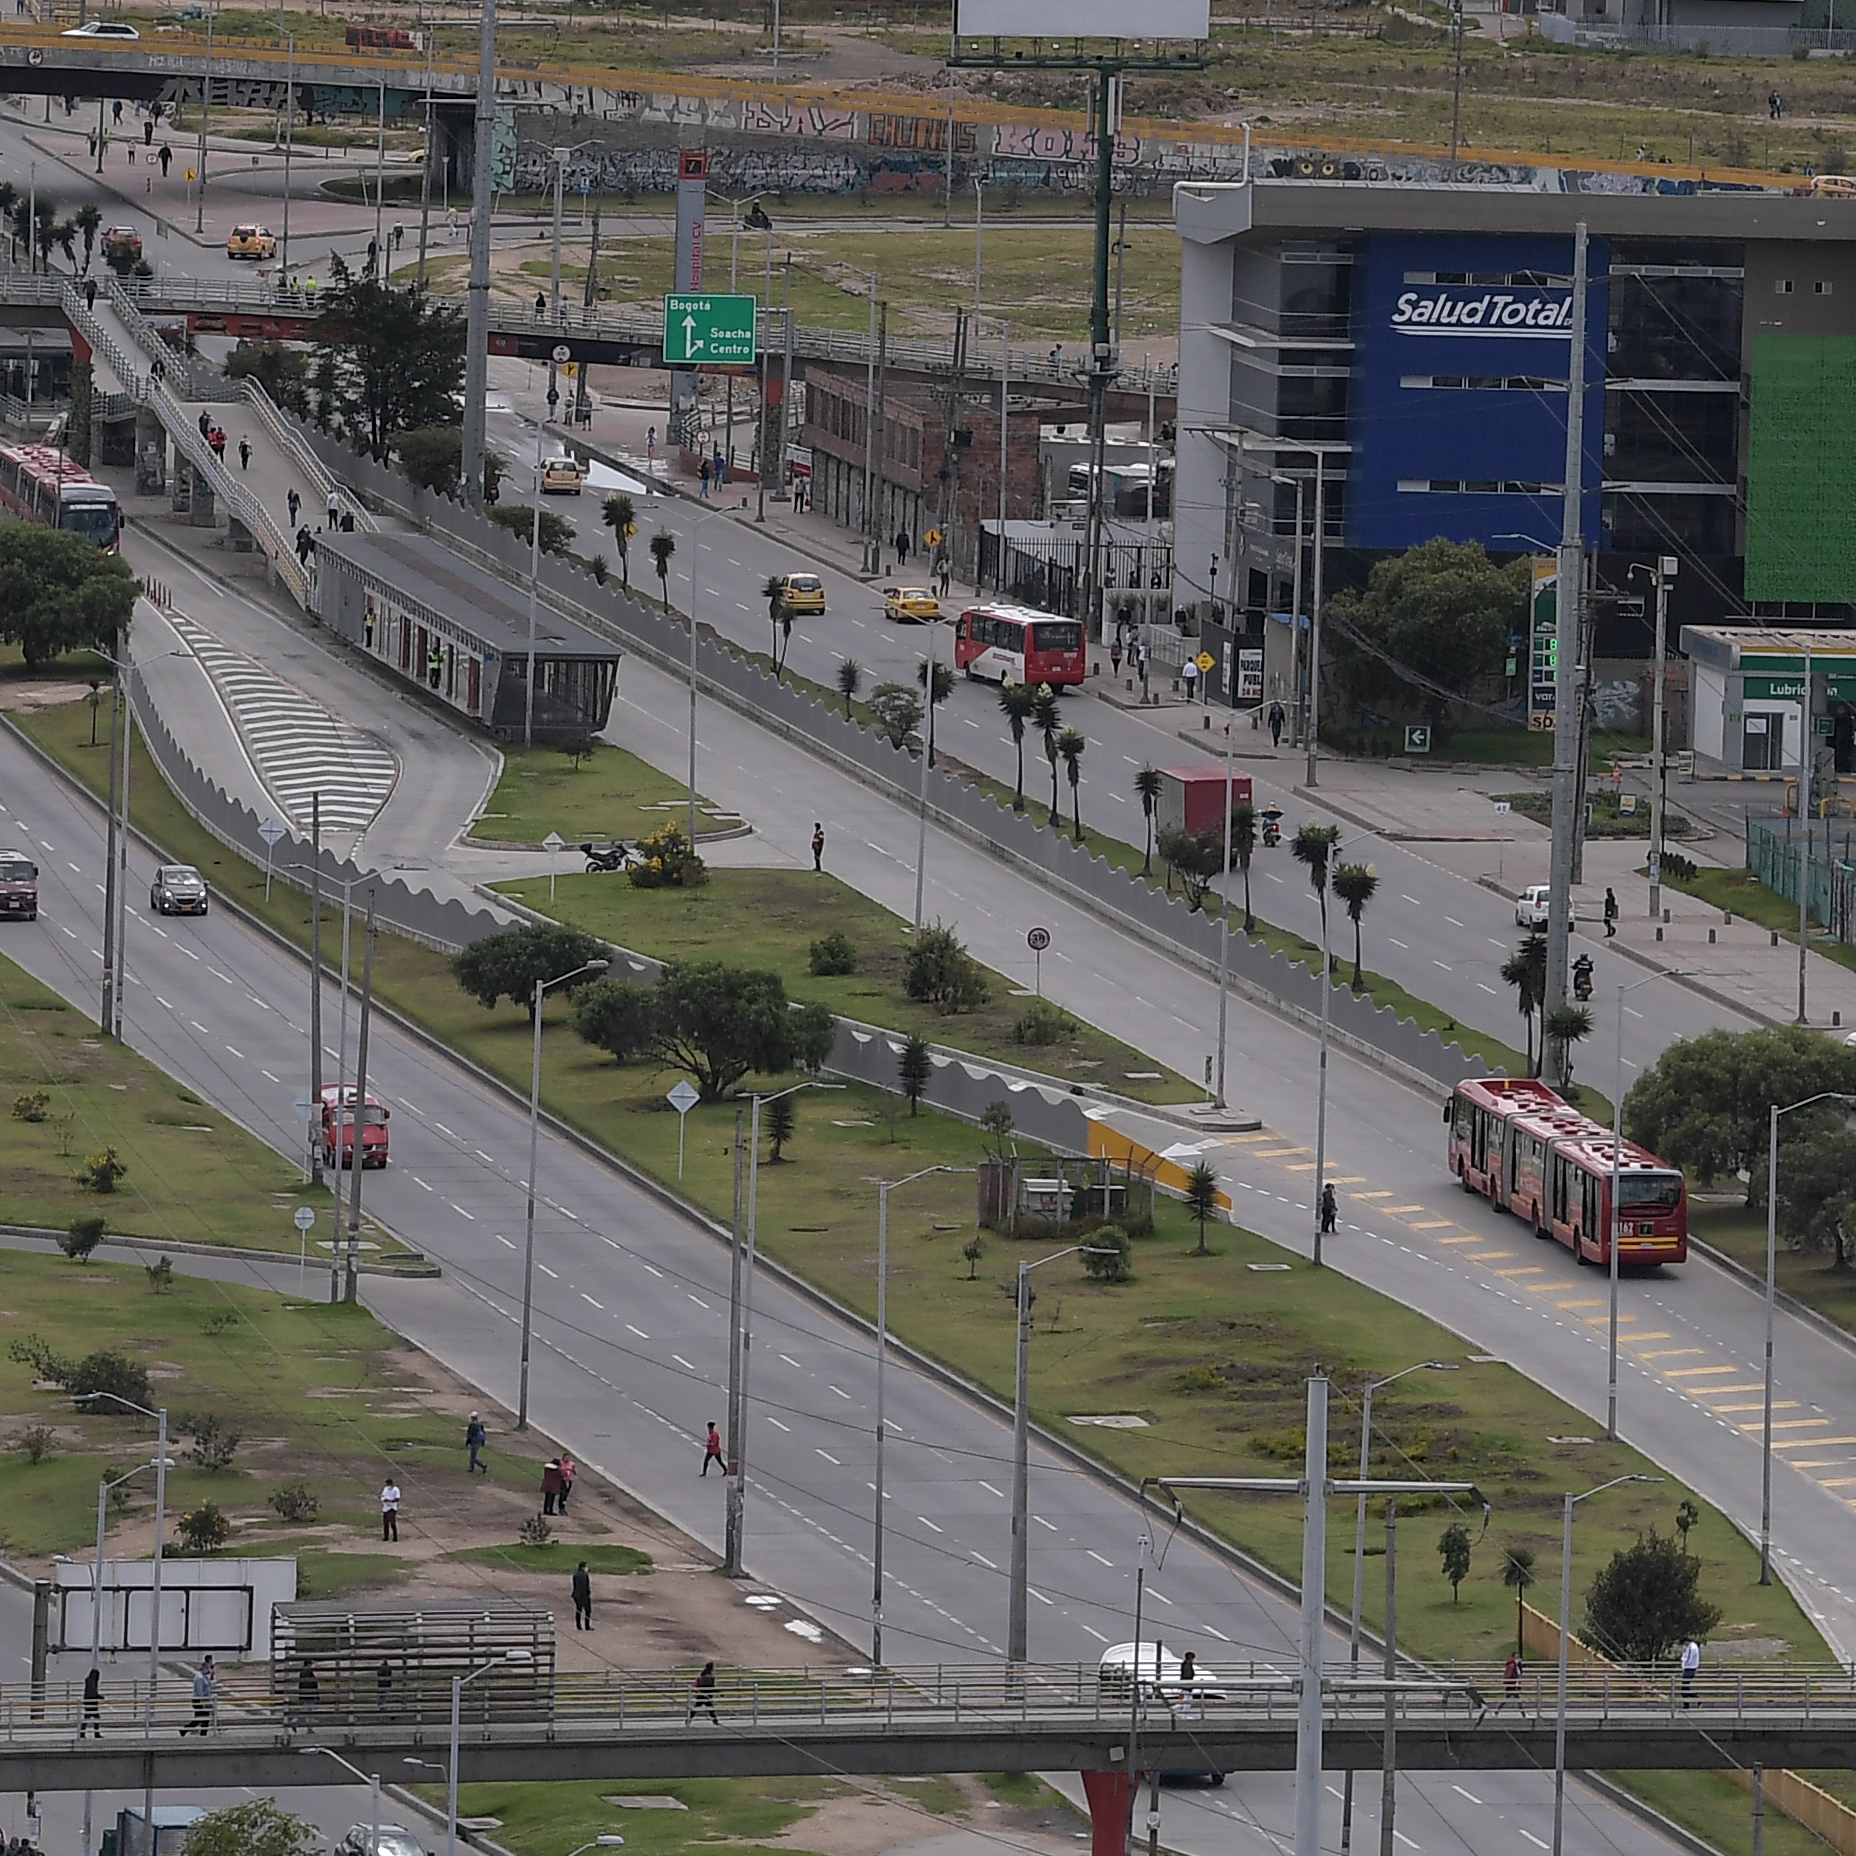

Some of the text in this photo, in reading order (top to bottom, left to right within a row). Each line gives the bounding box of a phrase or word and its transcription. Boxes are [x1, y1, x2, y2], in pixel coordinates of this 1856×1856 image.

[690, 242, 702, 291] Hospital
[669, 299, 711, 313] Bogotá
[709, 327, 752, 339] Soacha
[709, 343, 750, 354] Centro
